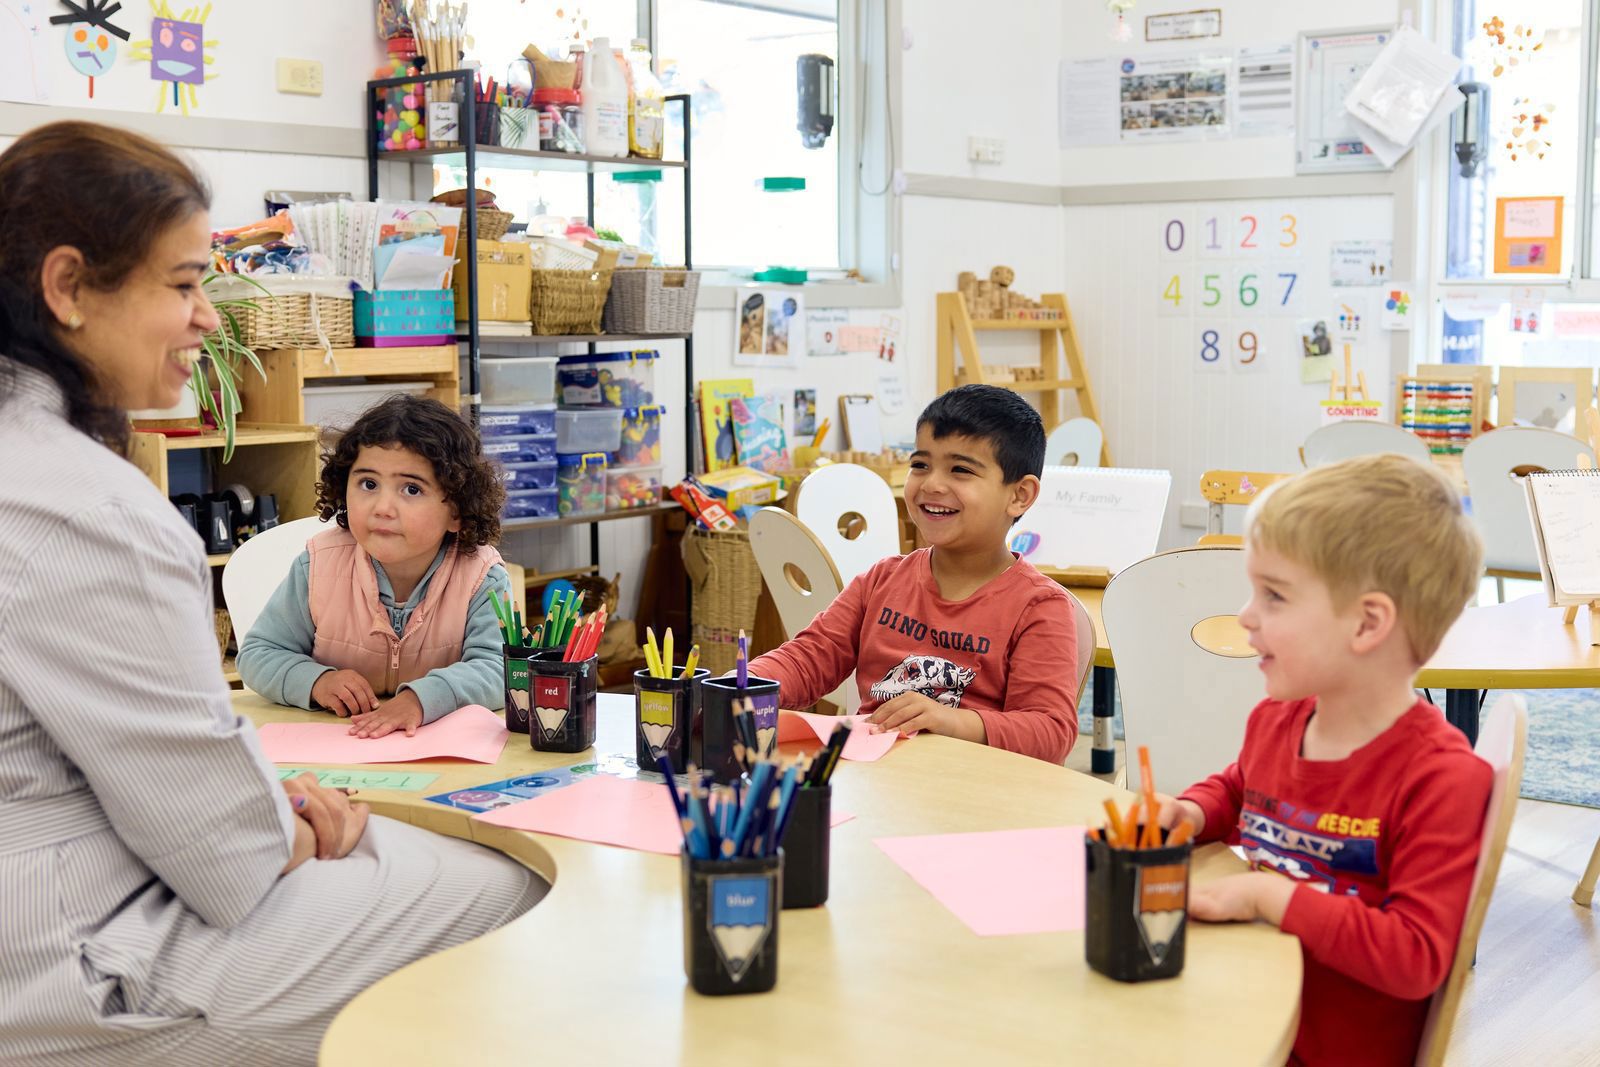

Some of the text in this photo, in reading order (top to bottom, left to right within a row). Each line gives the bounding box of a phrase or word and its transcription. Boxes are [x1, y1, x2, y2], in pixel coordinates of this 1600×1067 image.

[1165, 213, 1297, 252] 0 1 2 3
[1163, 272, 1298, 307] 4 5 6 7
[1200, 329, 1258, 365] 8 9
[1326, 405, 1379, 417] COUNTING
[1055, 490, 1124, 506] My Family
[878, 607, 991, 655] DINO SQUAD
[544, 687, 559, 696] red
[643, 702, 670, 713] yellow
[755, 704, 776, 717] urple
[1316, 812, 1381, 838] RESCUE
